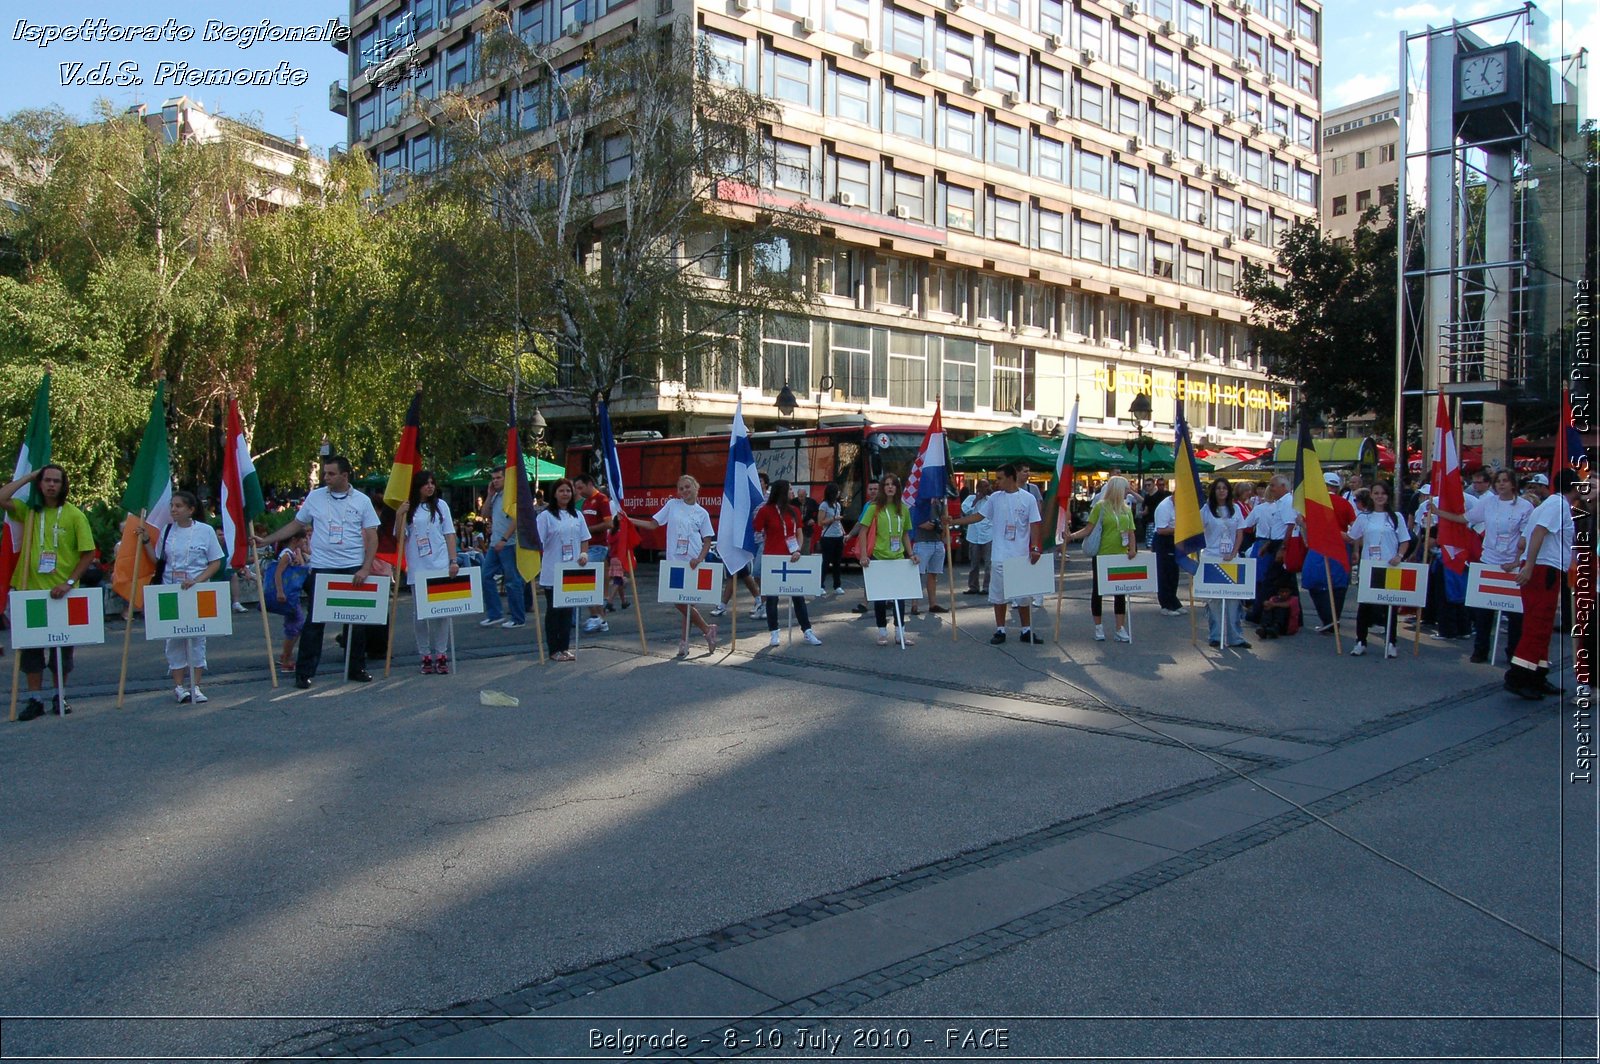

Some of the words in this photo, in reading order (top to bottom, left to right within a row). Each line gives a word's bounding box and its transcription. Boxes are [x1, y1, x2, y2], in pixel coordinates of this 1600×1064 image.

[1169, 379, 1220, 405] CENTAR
[778, 585, 804, 594] Finland
[1115, 584, 1142, 592] Bulgaria
[678, 593, 702, 602] France
[1377, 593, 1407, 604] Belgium
[1487, 599, 1515, 610] Austria
[430, 605, 463, 615] Germany
[333, 611, 368, 622] Hungary
[173, 624, 206, 634] Ireland
[48, 633, 70, 643] Italy
